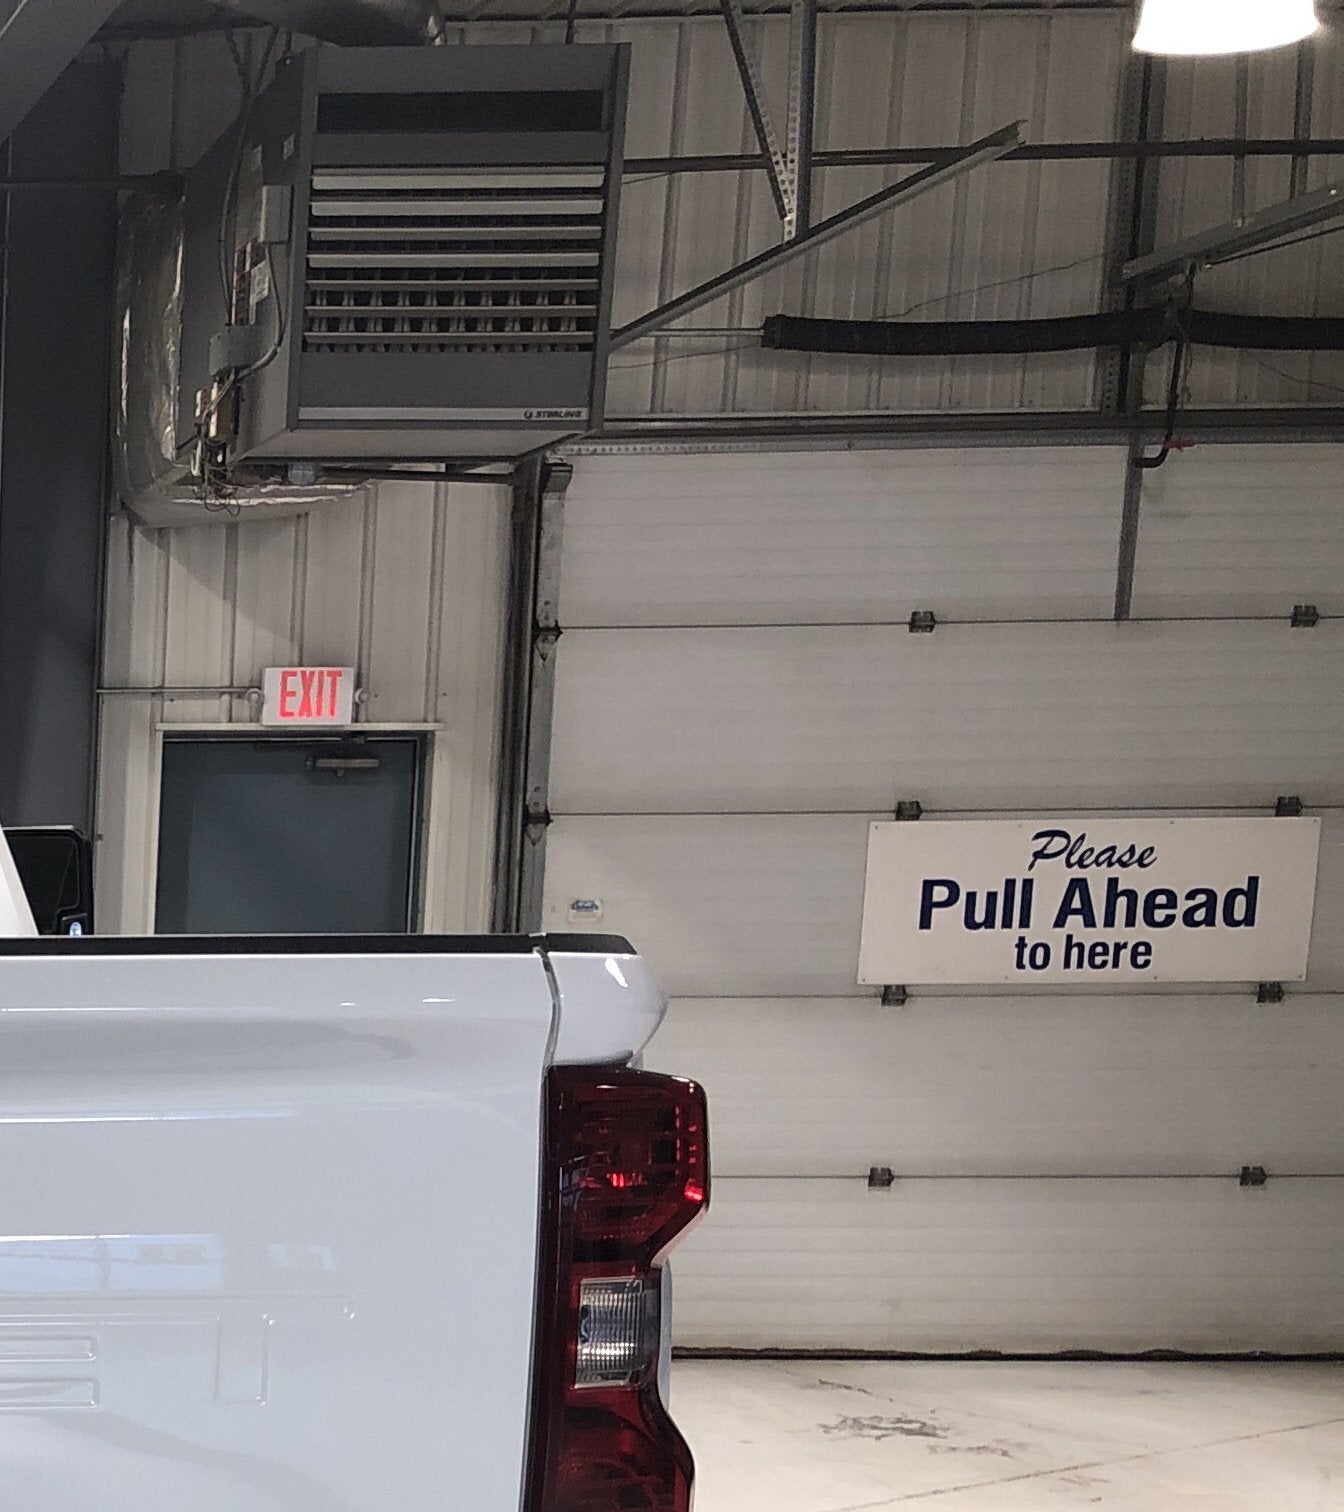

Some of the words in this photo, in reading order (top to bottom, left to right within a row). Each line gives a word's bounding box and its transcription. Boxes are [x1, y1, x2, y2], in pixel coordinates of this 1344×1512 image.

[279, 669, 343, 718] EXIT
[1028, 829, 1158, 870] Please
[918, 878, 1034, 930] Pull
[1052, 875, 1260, 929] Ahead
[1015, 936, 1050, 970] to
[1063, 934, 1153, 970] here
